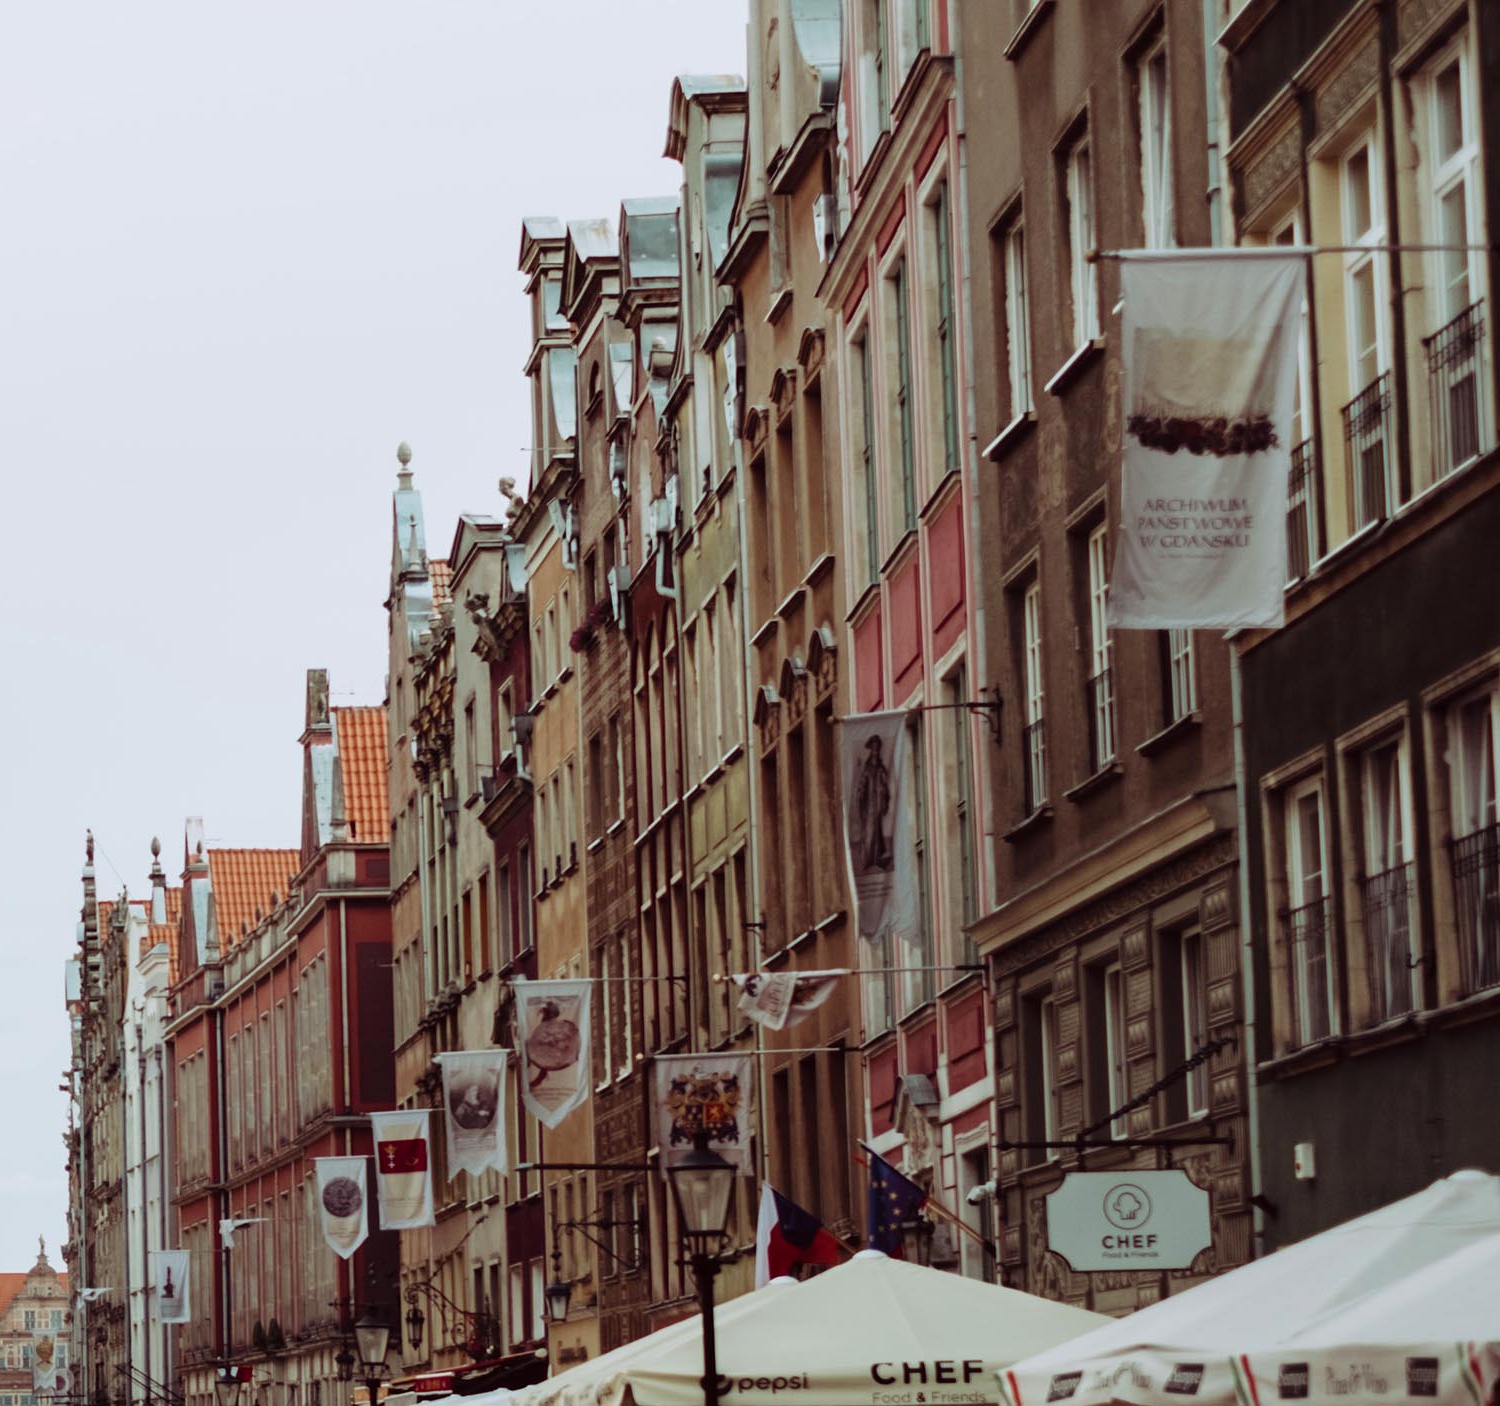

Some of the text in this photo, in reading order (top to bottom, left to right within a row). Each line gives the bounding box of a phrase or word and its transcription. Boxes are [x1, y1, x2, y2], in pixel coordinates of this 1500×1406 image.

[1139, 535, 1156, 548] W
[1101, 1234, 1157, 1249] CHEF
[871, 1360, 983, 1385] CHEF
[738, 1373, 810, 1394] pepsi
[872, 1390, 987, 1404] Food & Friends
